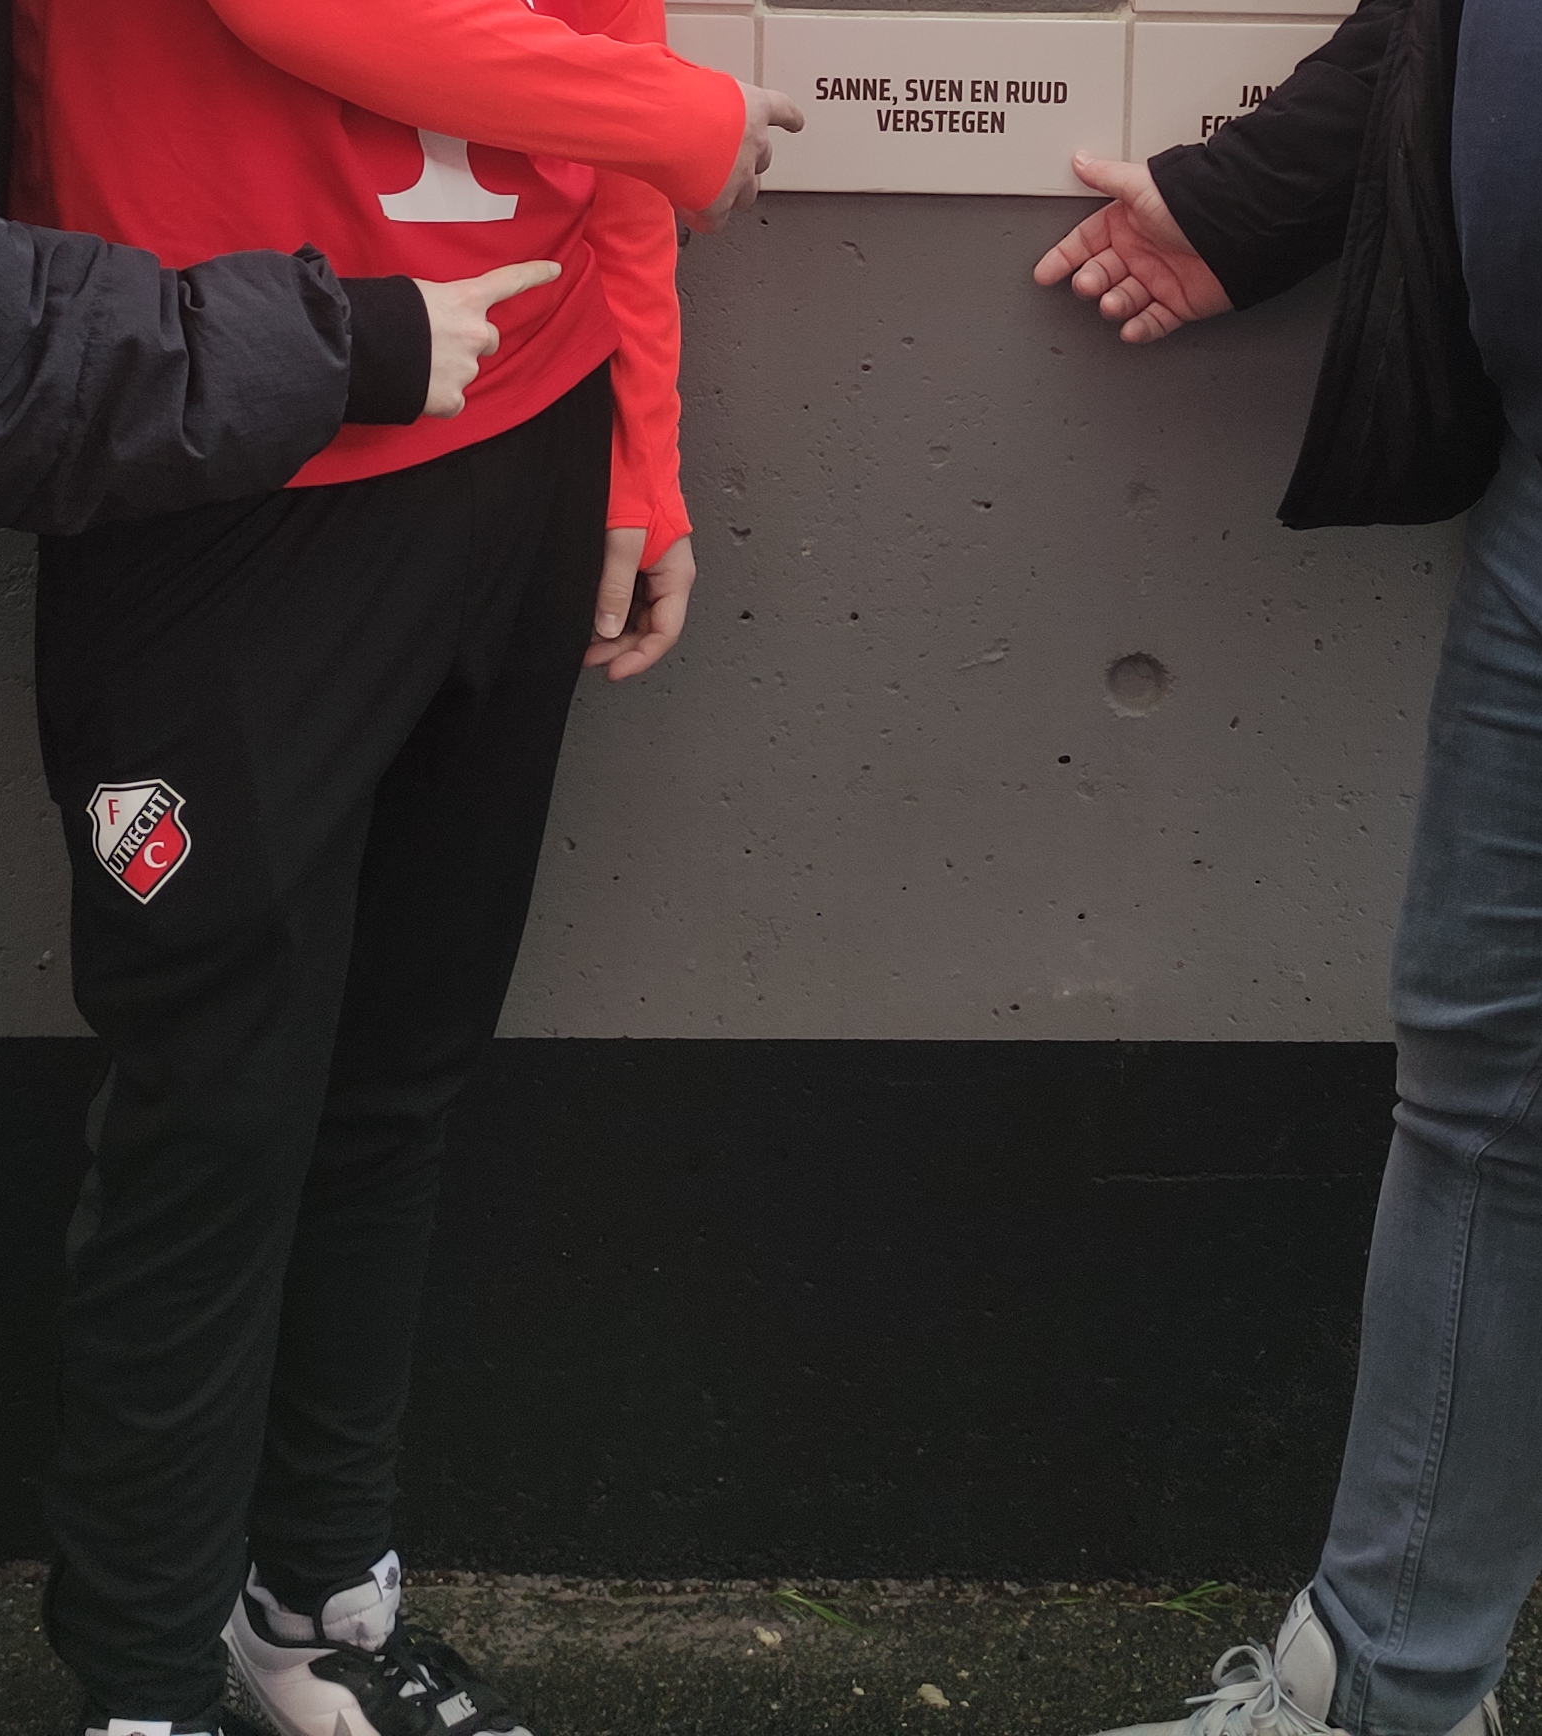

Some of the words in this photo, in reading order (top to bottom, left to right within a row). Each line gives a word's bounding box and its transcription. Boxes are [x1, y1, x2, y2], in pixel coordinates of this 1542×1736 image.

[815, 77, 898, 106] SANNE,
[905, 78, 963, 103] SVEN
[970, 80, 999, 103] EN
[1005, 80, 1068, 104] RUUD
[876, 109, 1005, 134] VERSTEGEN
[108, 799, 120, 825] F
[109, 789, 171, 875] UTRECHT
[143, 842, 168, 868] C
